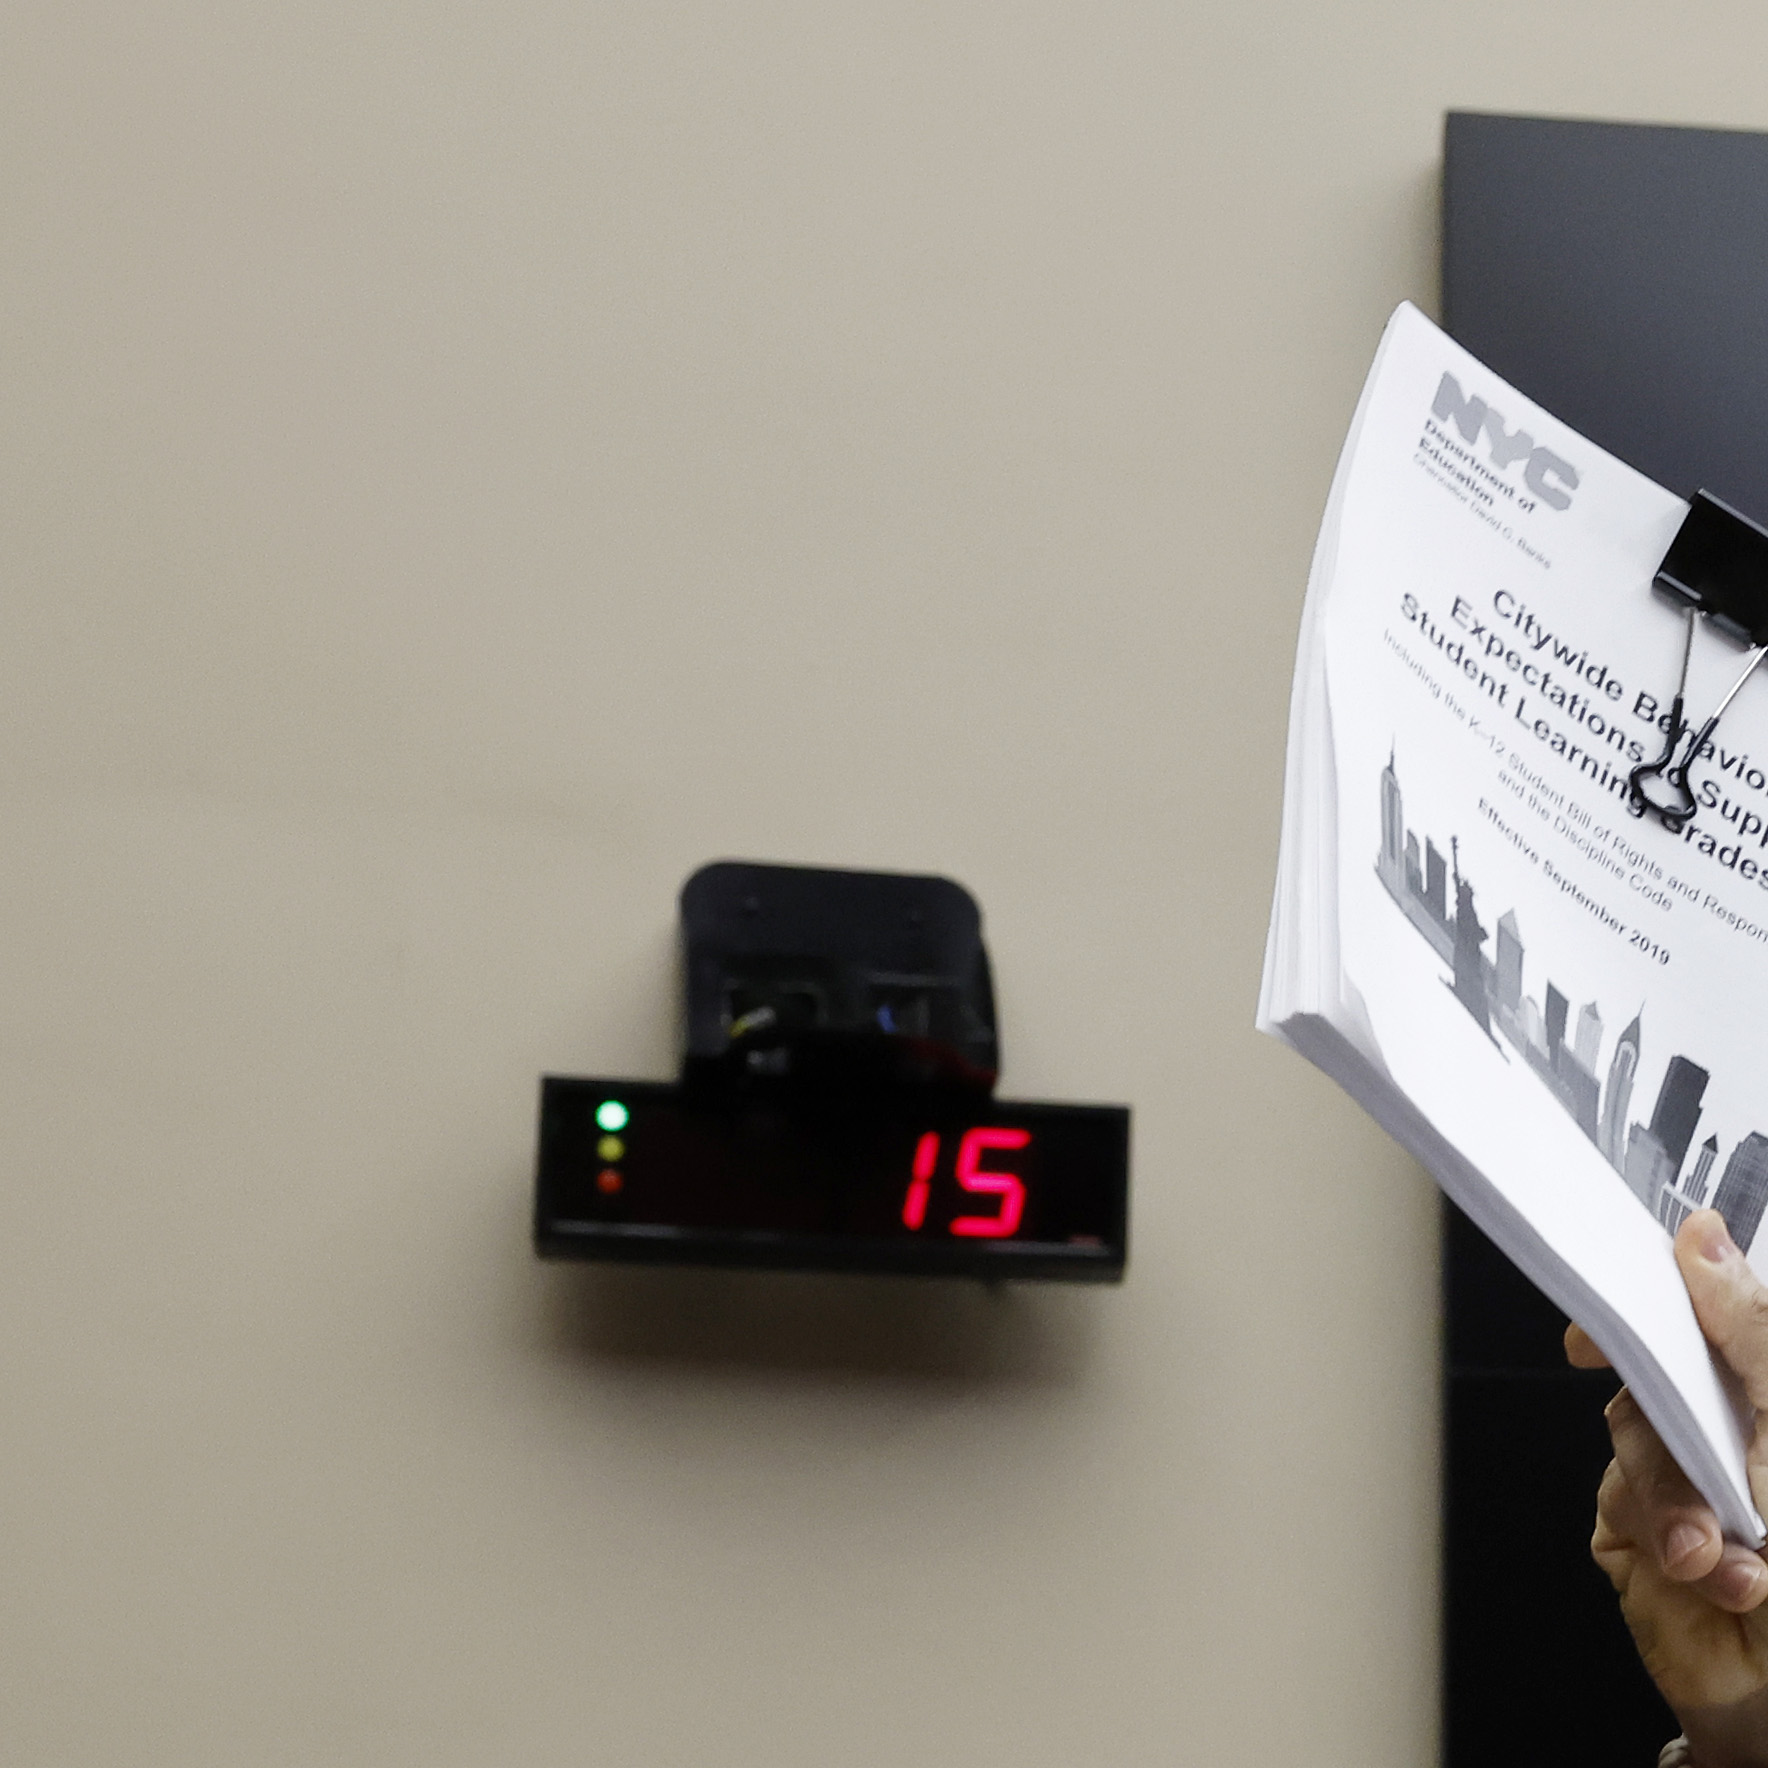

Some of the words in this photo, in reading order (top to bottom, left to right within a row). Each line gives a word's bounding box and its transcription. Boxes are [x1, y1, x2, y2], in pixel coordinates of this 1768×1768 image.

[1419, 437, 1494, 506] Education
[1424, 418, 1515, 499] Department
[1518, 497, 1536, 514] of
[1431, 370, 1580, 511] NYC
[1400, 592, 1509, 708] Student
[1514, 697, 1648, 820] Learning
[1451, 595, 1646, 764] Expectations
[1493, 589, 1624, 702] Citywide
[1383, 627, 1441, 700] Including
[1445, 693, 1465, 721] the
[1508, 752, 1565, 807] Student
[1567, 801, 1592, 829] Bill
[1593, 825, 1612, 848] of
[1612, 835, 1664, 881] Rights
[1667, 876, 1701, 903] and
[1478, 798, 1539, 864] Effective
[1542, 859, 1627, 935] September
[1629, 930, 1671, 966] 2019
[1497, 769, 1526, 800] and
[1528, 795, 1550, 822] the
[1553, 817, 1626, 880] Discipline
[1629, 873, 1673, 912] Code
[902, 1126, 1032, 1238] 15
